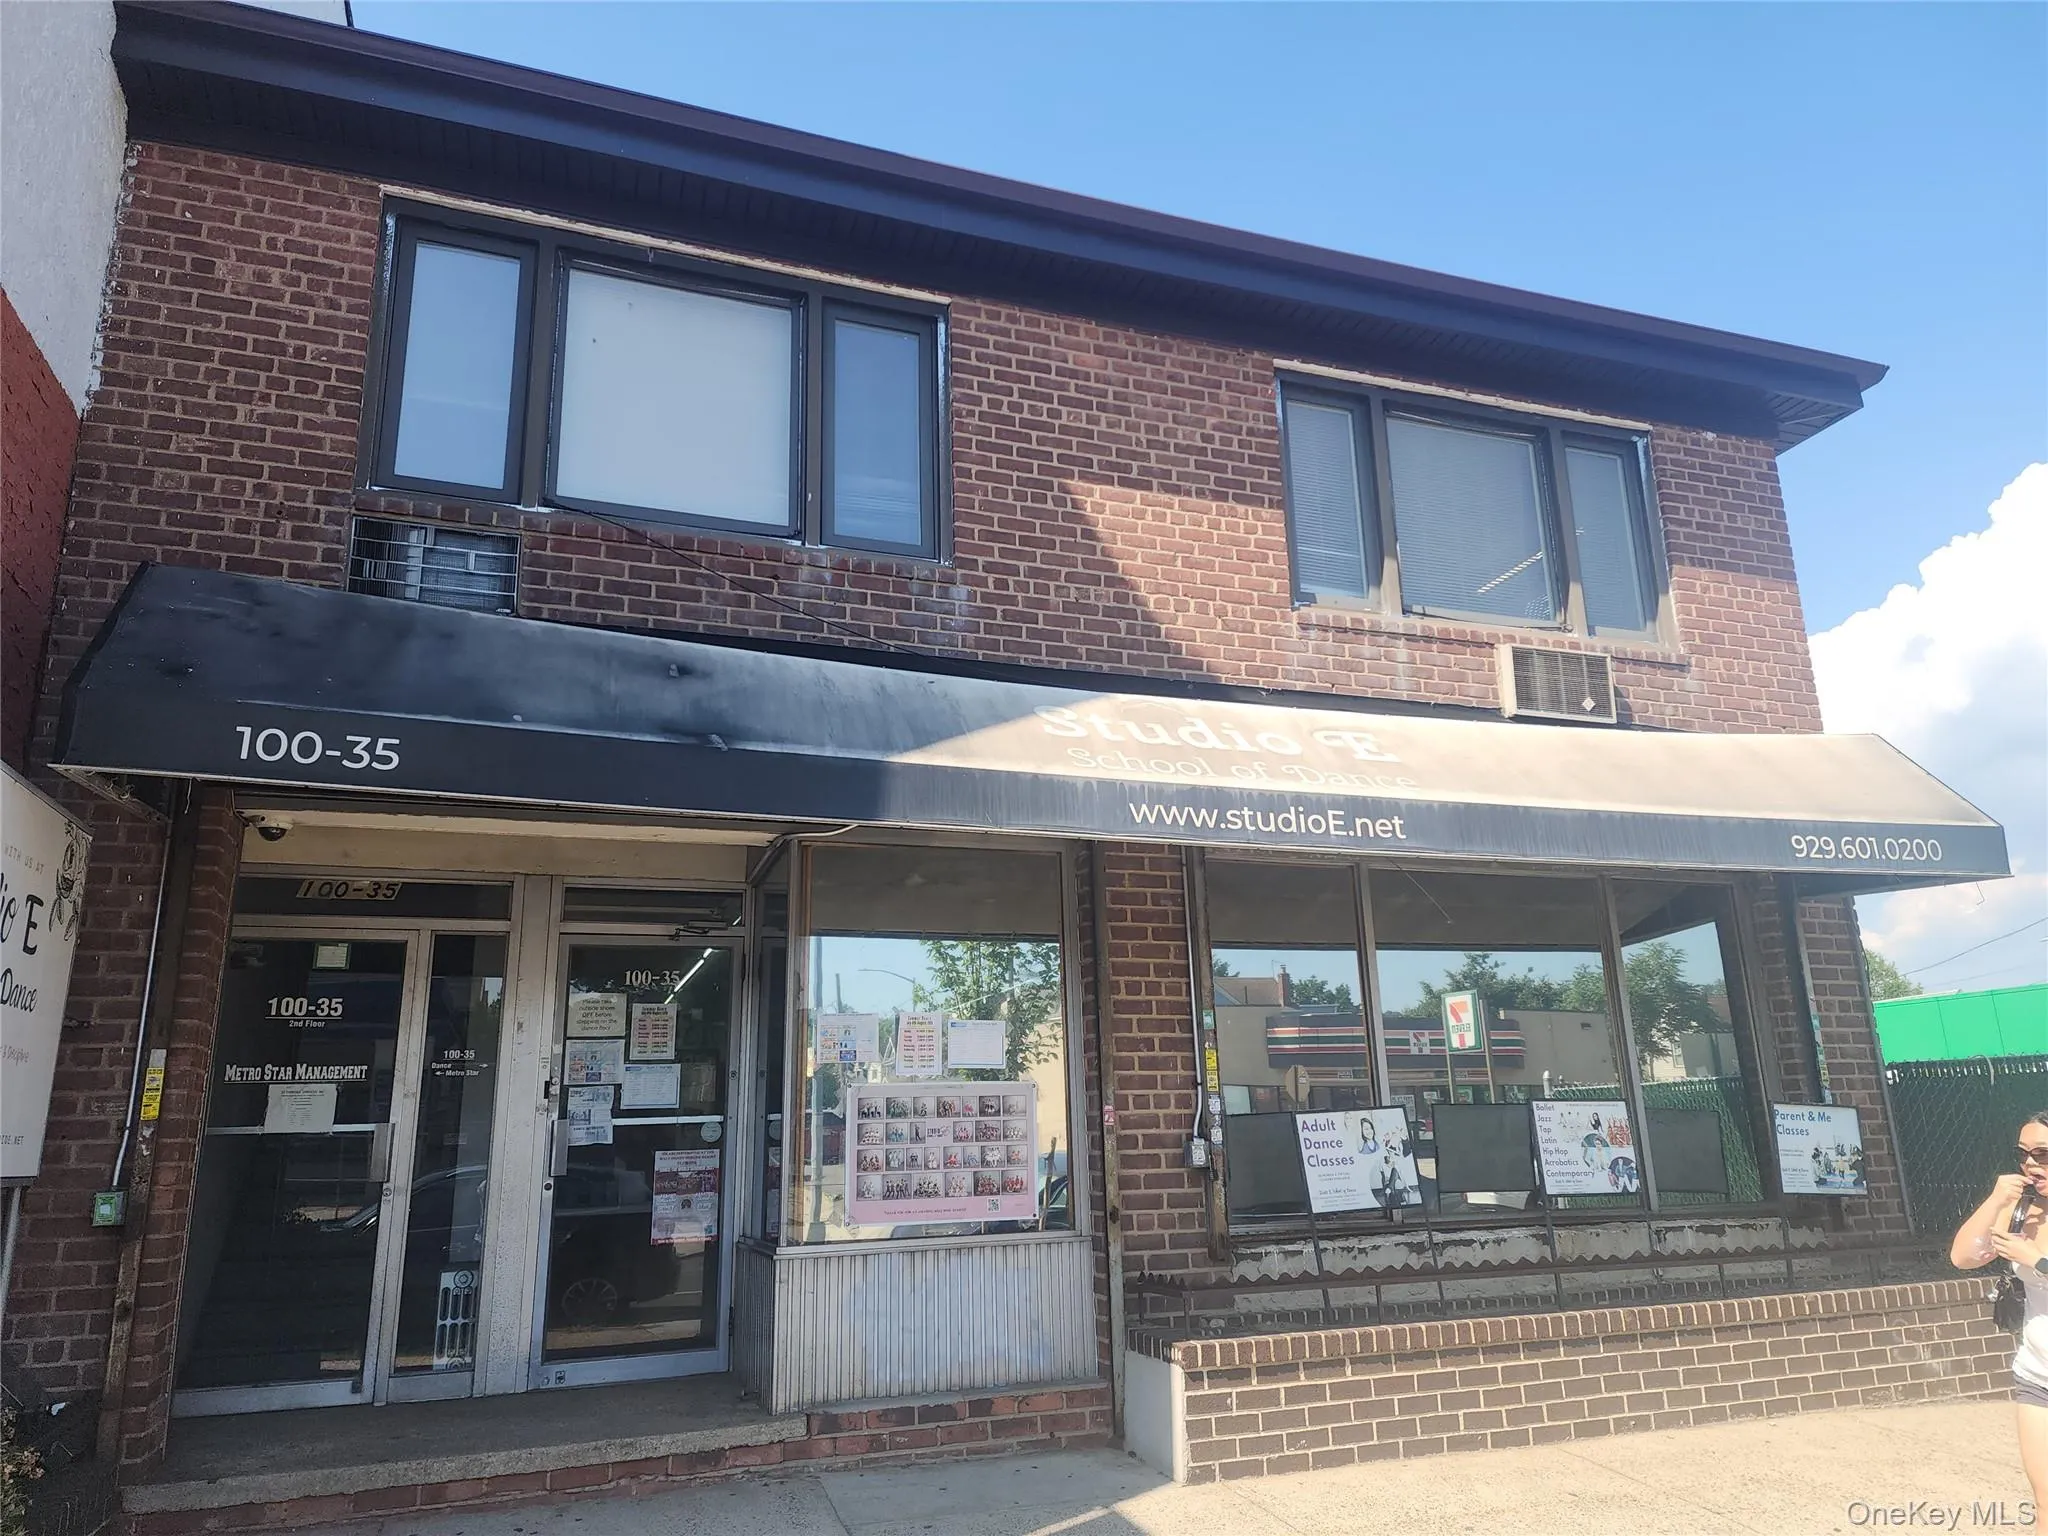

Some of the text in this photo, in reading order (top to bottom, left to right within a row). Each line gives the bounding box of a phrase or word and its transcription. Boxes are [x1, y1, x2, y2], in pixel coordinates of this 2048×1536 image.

[1033, 705, 1304, 756] Studio
[235, 726, 400, 771] 100-35
[1066, 746, 1421, 791] School of Dance
[1128, 799, 1408, 841] www.studioE.net
[1791, 834, 1943, 862] 929.601.0200
[302, 880, 399, 899] 100-35
[22, 893, 45, 956] E
[624, 969, 681, 986] 100-35
[0, 967, 38, 1013] Dance
[268, 997, 344, 1017] 100-35
[289, 1019, 326, 1028] 2nd Floor
[443, 1049, 476, 1059] 100-35
[264, 1063, 293, 1081] STAR
[295, 1063, 368, 1080] MANAGEMENT
[1535, 1103, 1555, 1111] Ballet
[1537, 1114, 1552, 1122] Jazz
[1774, 1109, 1832, 1122] Parent & Me
[1301, 1118, 1336, 1132] Adult
[1539, 1125, 1552, 1134] Tap
[1776, 1124, 1810, 1136] Classes
[1303, 1137, 1344, 1150] Dance
[1540, 1136, 1558, 1144] Latin
[1542, 1147, 1569, 1156] Hip Hop
[1306, 1153, 1355, 1168] Classes
[1544, 1158, 1579, 1166] Acrobatics
[1545, 1169, 1595, 1179] Contemporary
